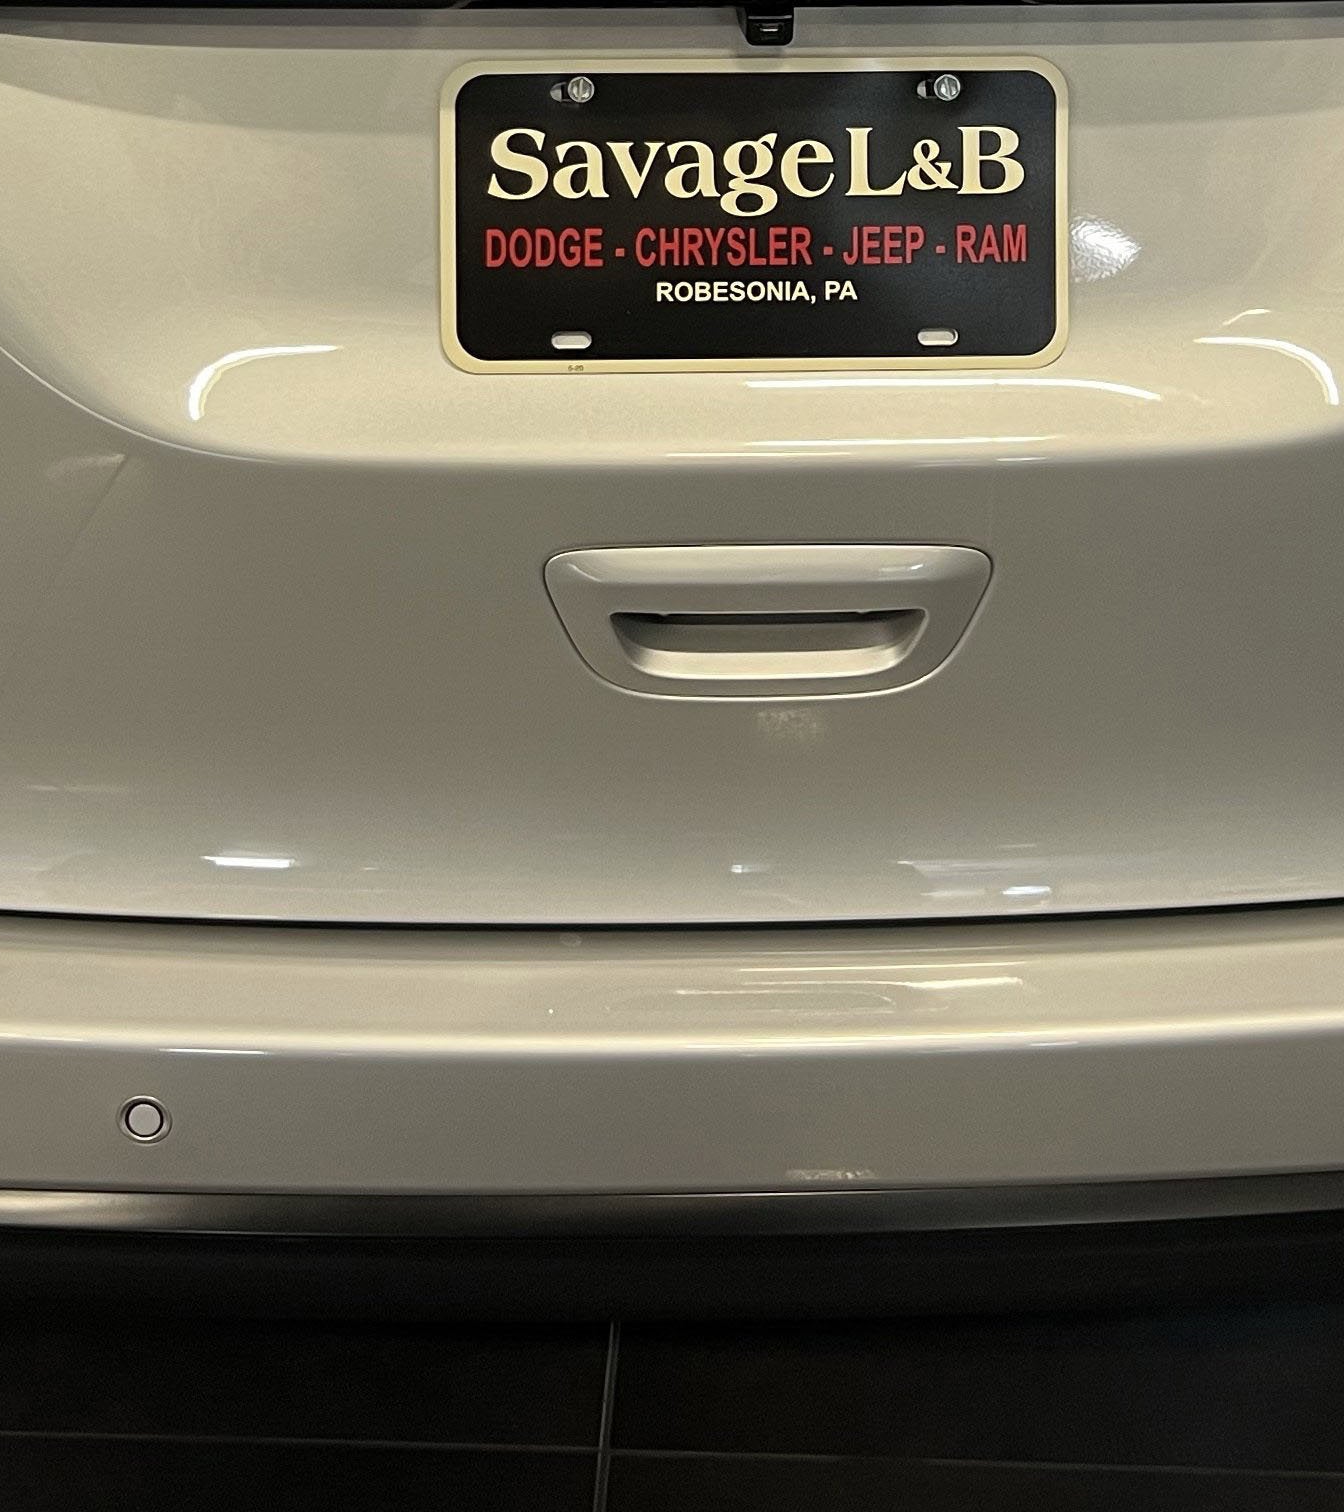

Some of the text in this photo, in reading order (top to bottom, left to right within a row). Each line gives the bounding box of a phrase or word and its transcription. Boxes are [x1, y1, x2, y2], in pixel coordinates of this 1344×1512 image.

[485, 227, 604, 268] DODGE
[635, 226, 812, 267] CHRYSLER
[842, 225, 925, 265] JEEP
[955, 224, 1027, 263] RAM
[656, 280, 858, 305] ROBESONIA, PA
